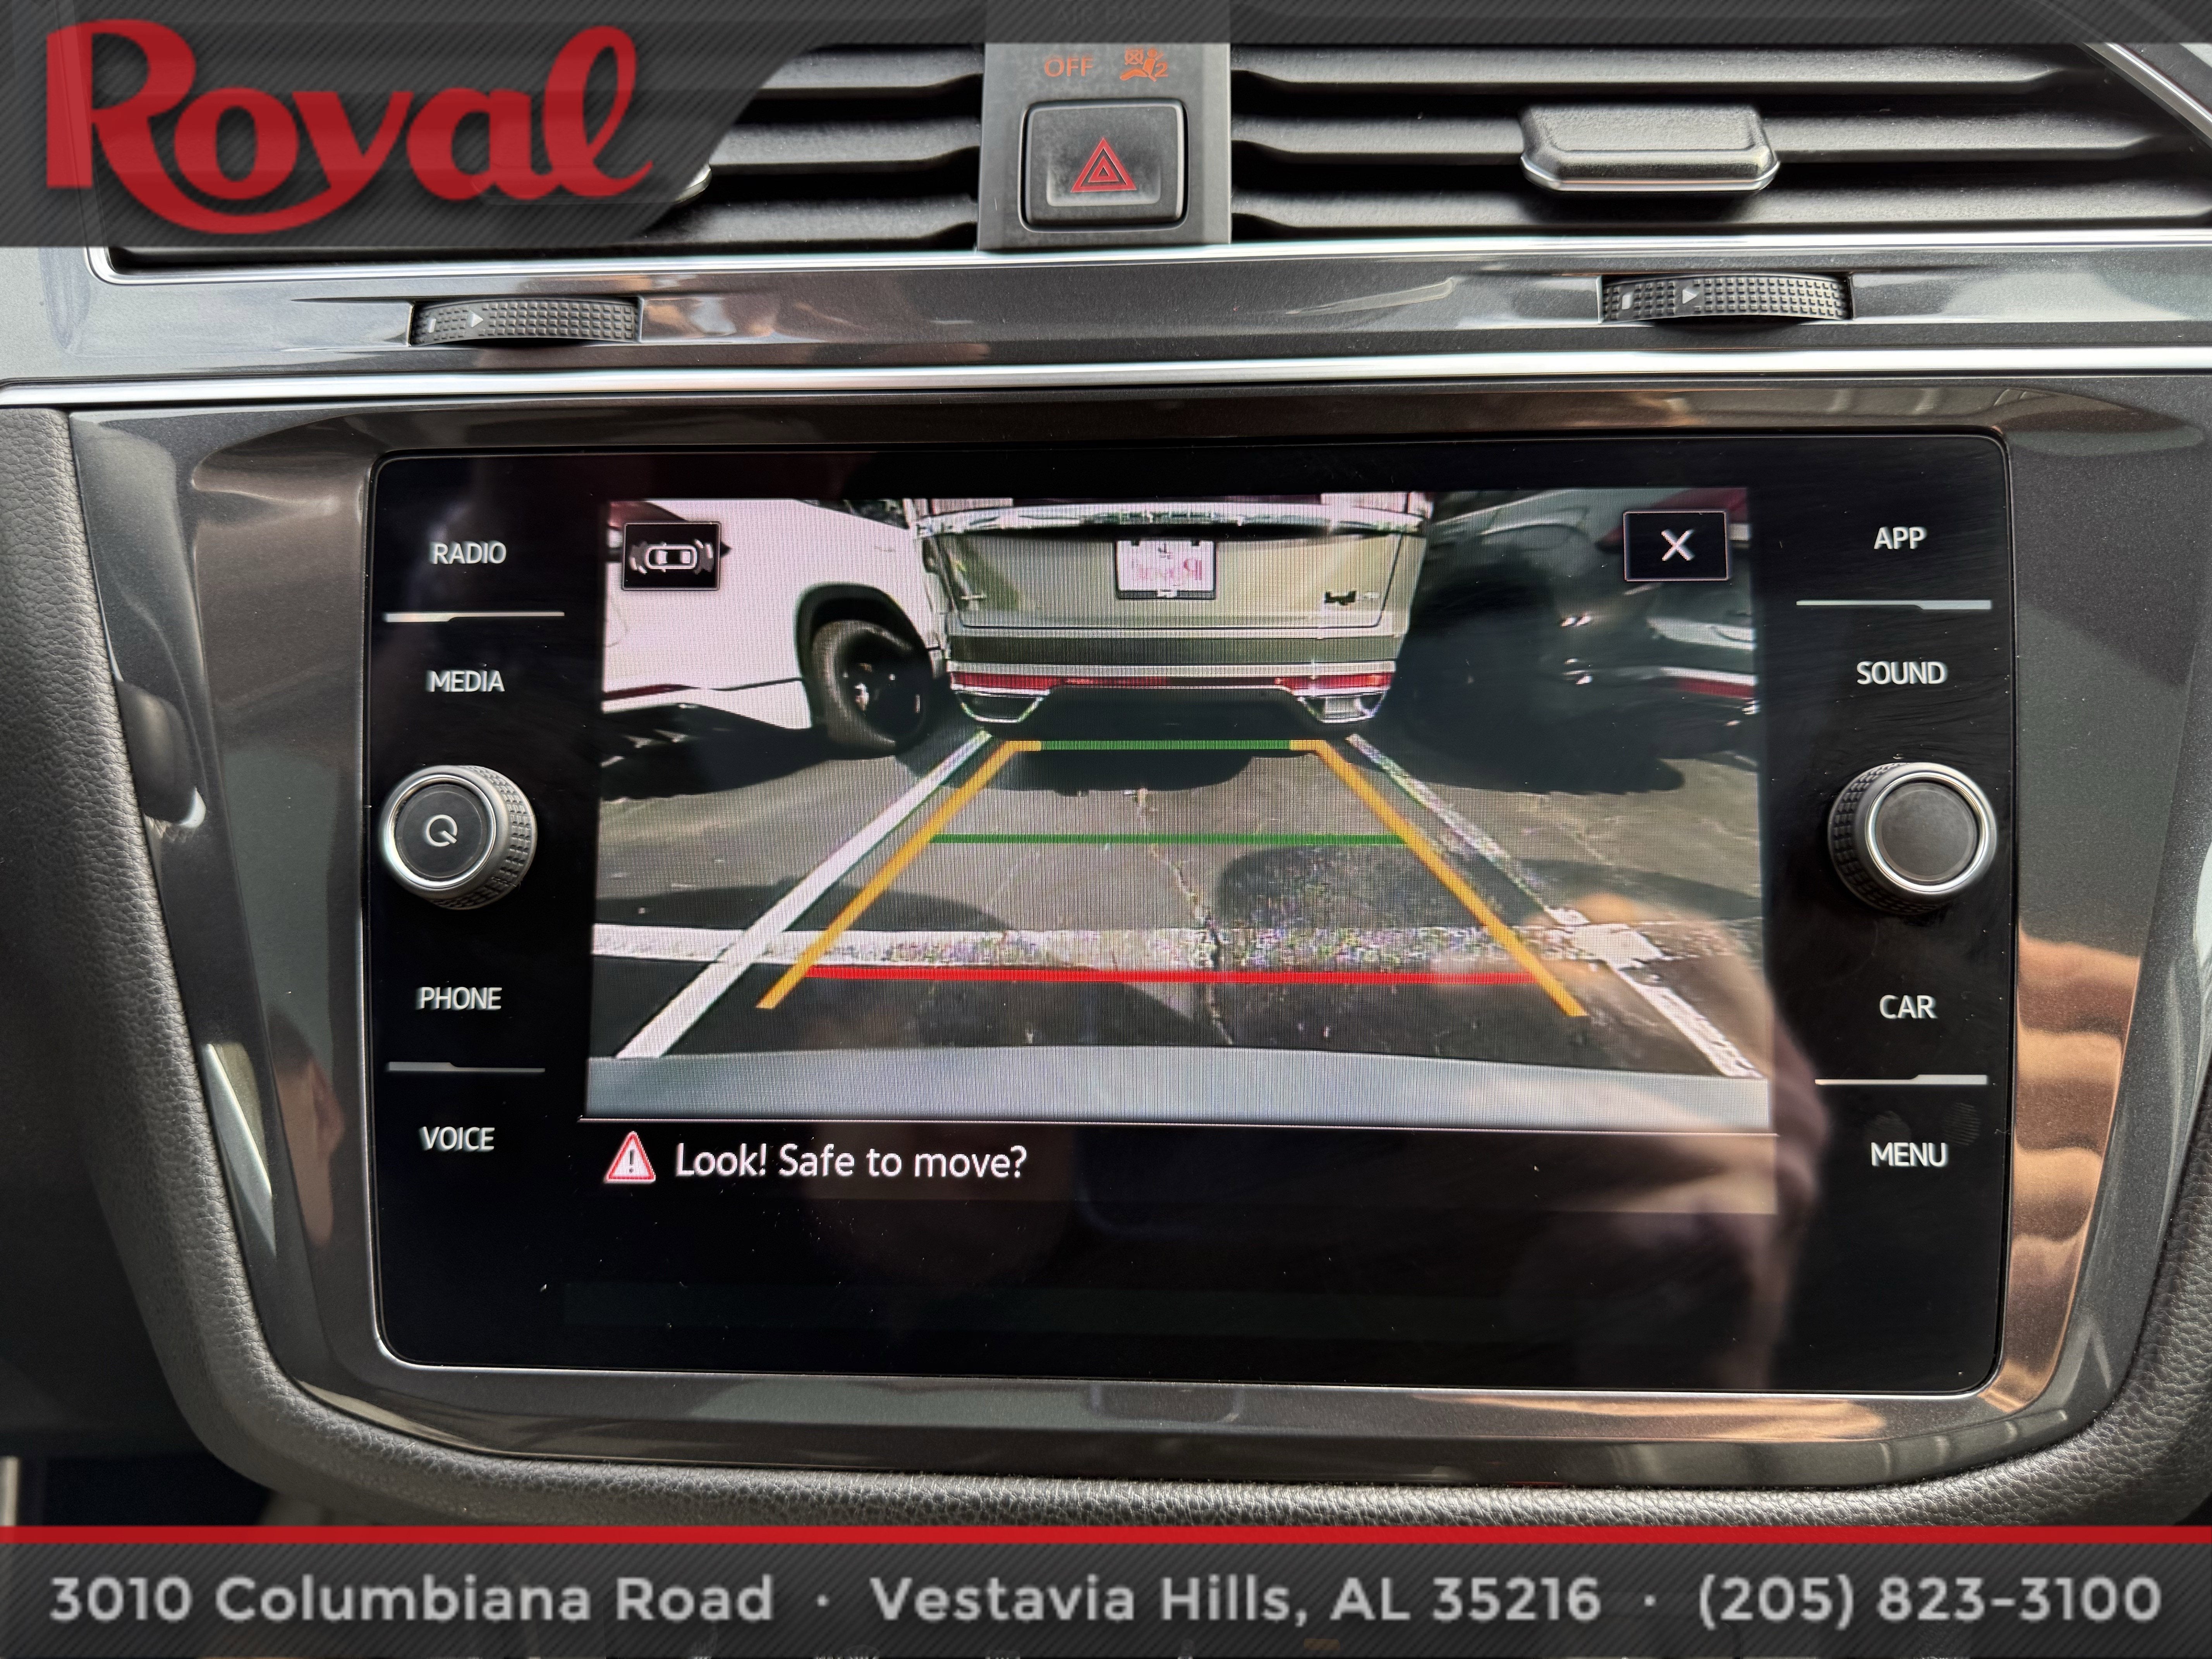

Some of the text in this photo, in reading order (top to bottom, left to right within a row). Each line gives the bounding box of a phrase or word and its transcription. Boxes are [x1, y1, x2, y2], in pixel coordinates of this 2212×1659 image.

[1044, 57, 1094, 77] OFF
[1874, 526, 1927, 550] APP
[431, 541, 507, 564] RADIO
[428, 670, 505, 692] MEDIA
[1856, 661, 1948, 685] SOUND
[417, 987, 502, 1010] PHONE
[1879, 994, 1937, 1019] CAR
[421, 1126, 495, 1151] VOICE
[676, 1143, 1027, 1178] Look! Safe to move?
[1871, 1142, 1948, 1167] MENU
